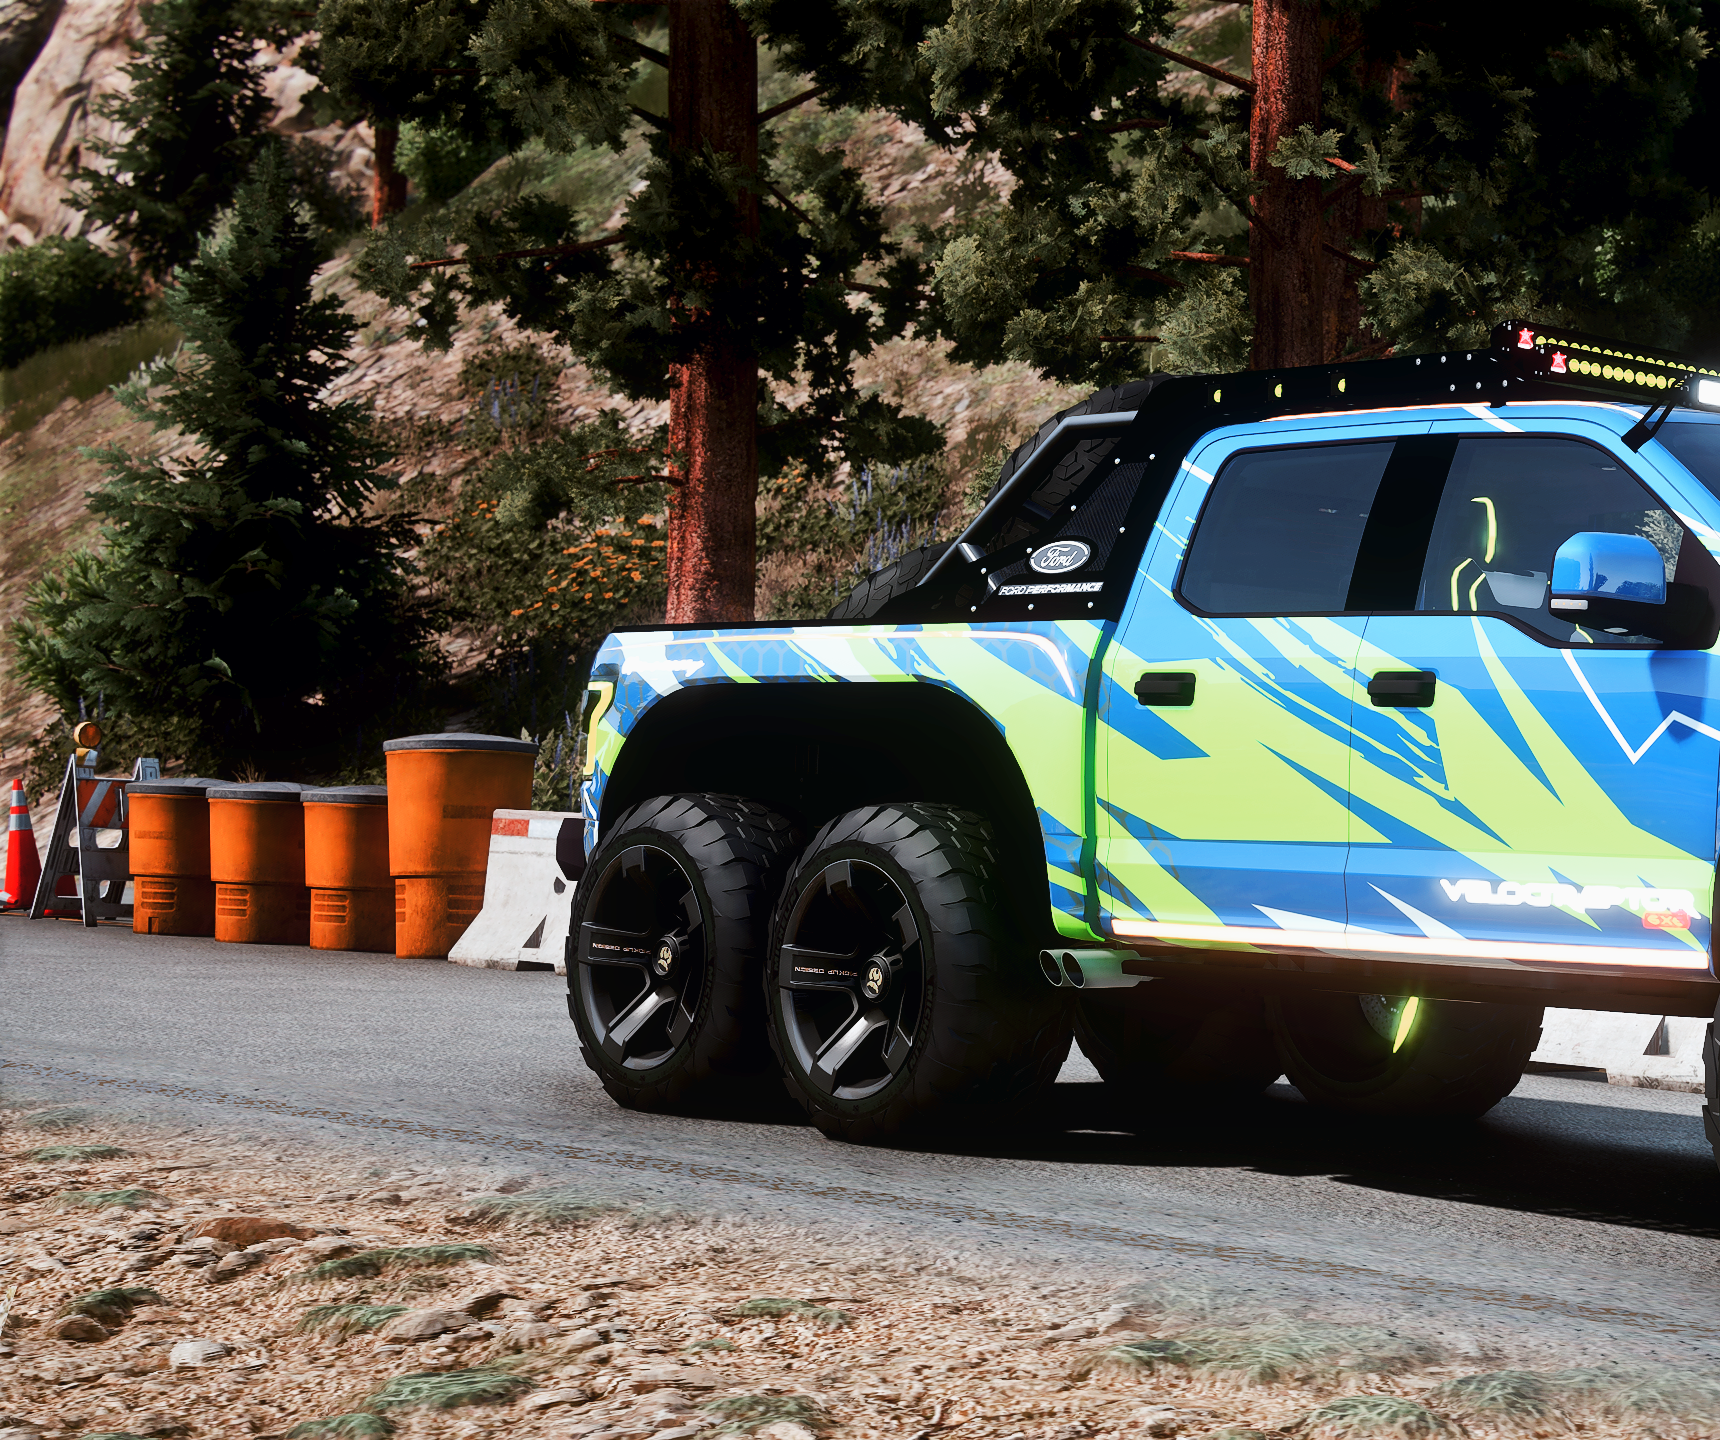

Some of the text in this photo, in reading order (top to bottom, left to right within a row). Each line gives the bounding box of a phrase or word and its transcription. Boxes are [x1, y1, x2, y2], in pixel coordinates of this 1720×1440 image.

[1040, 546, 1078, 568] Ford
[998, 582, 1104, 596] FORD PERFORMANCE
